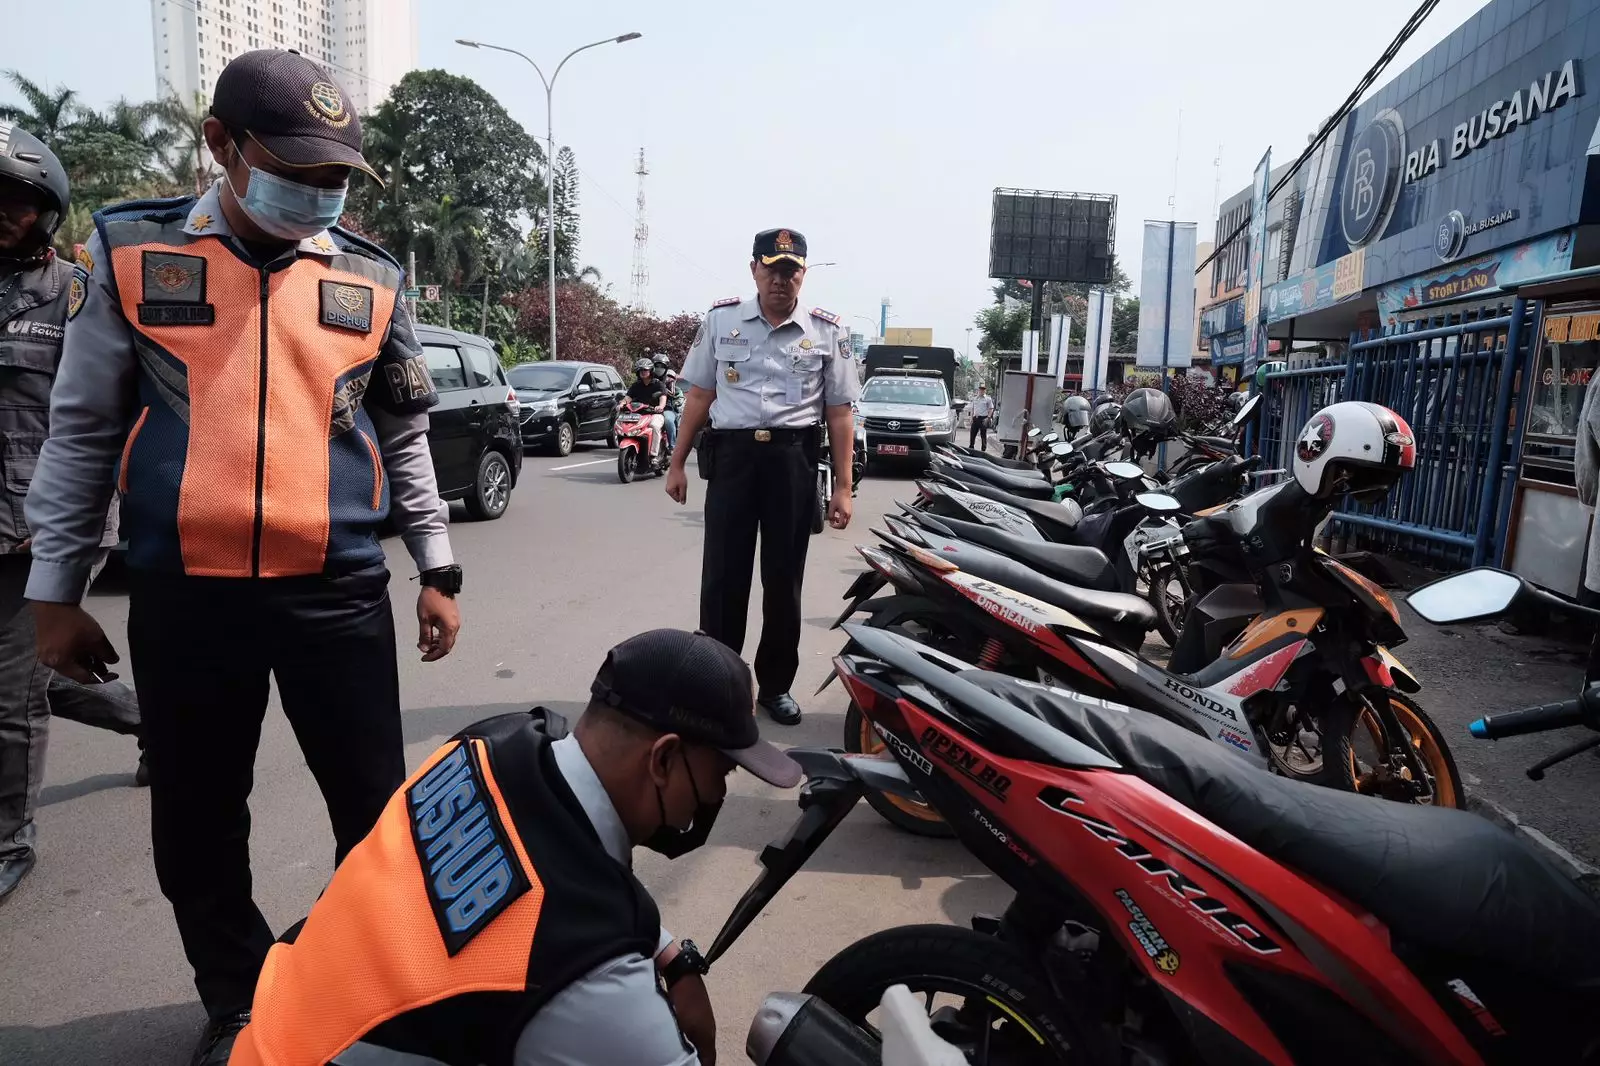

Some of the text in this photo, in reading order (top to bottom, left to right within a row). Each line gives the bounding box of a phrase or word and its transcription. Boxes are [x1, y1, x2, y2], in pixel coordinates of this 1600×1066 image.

[1405, 59, 1577, 184] RIA BUSANA
[1464, 209, 1513, 237] RIA BUSANA
[1429, 273, 1489, 300] STORY LAND
[31, 326, 64, 338] SQUAD
[327, 311, 369, 330] DISHUB
[872, 380, 937, 388] PATROLI
[976, 594, 999, 613] One
[1164, 678, 1238, 722] HONDA
[883, 731, 934, 776] IPONE
[920, 726, 980, 773] OPEN
[410, 746, 513, 933] DISHUB
[1036, 785, 1282, 955] VARIO
[1114, 889, 1169, 950] PASUKAN
